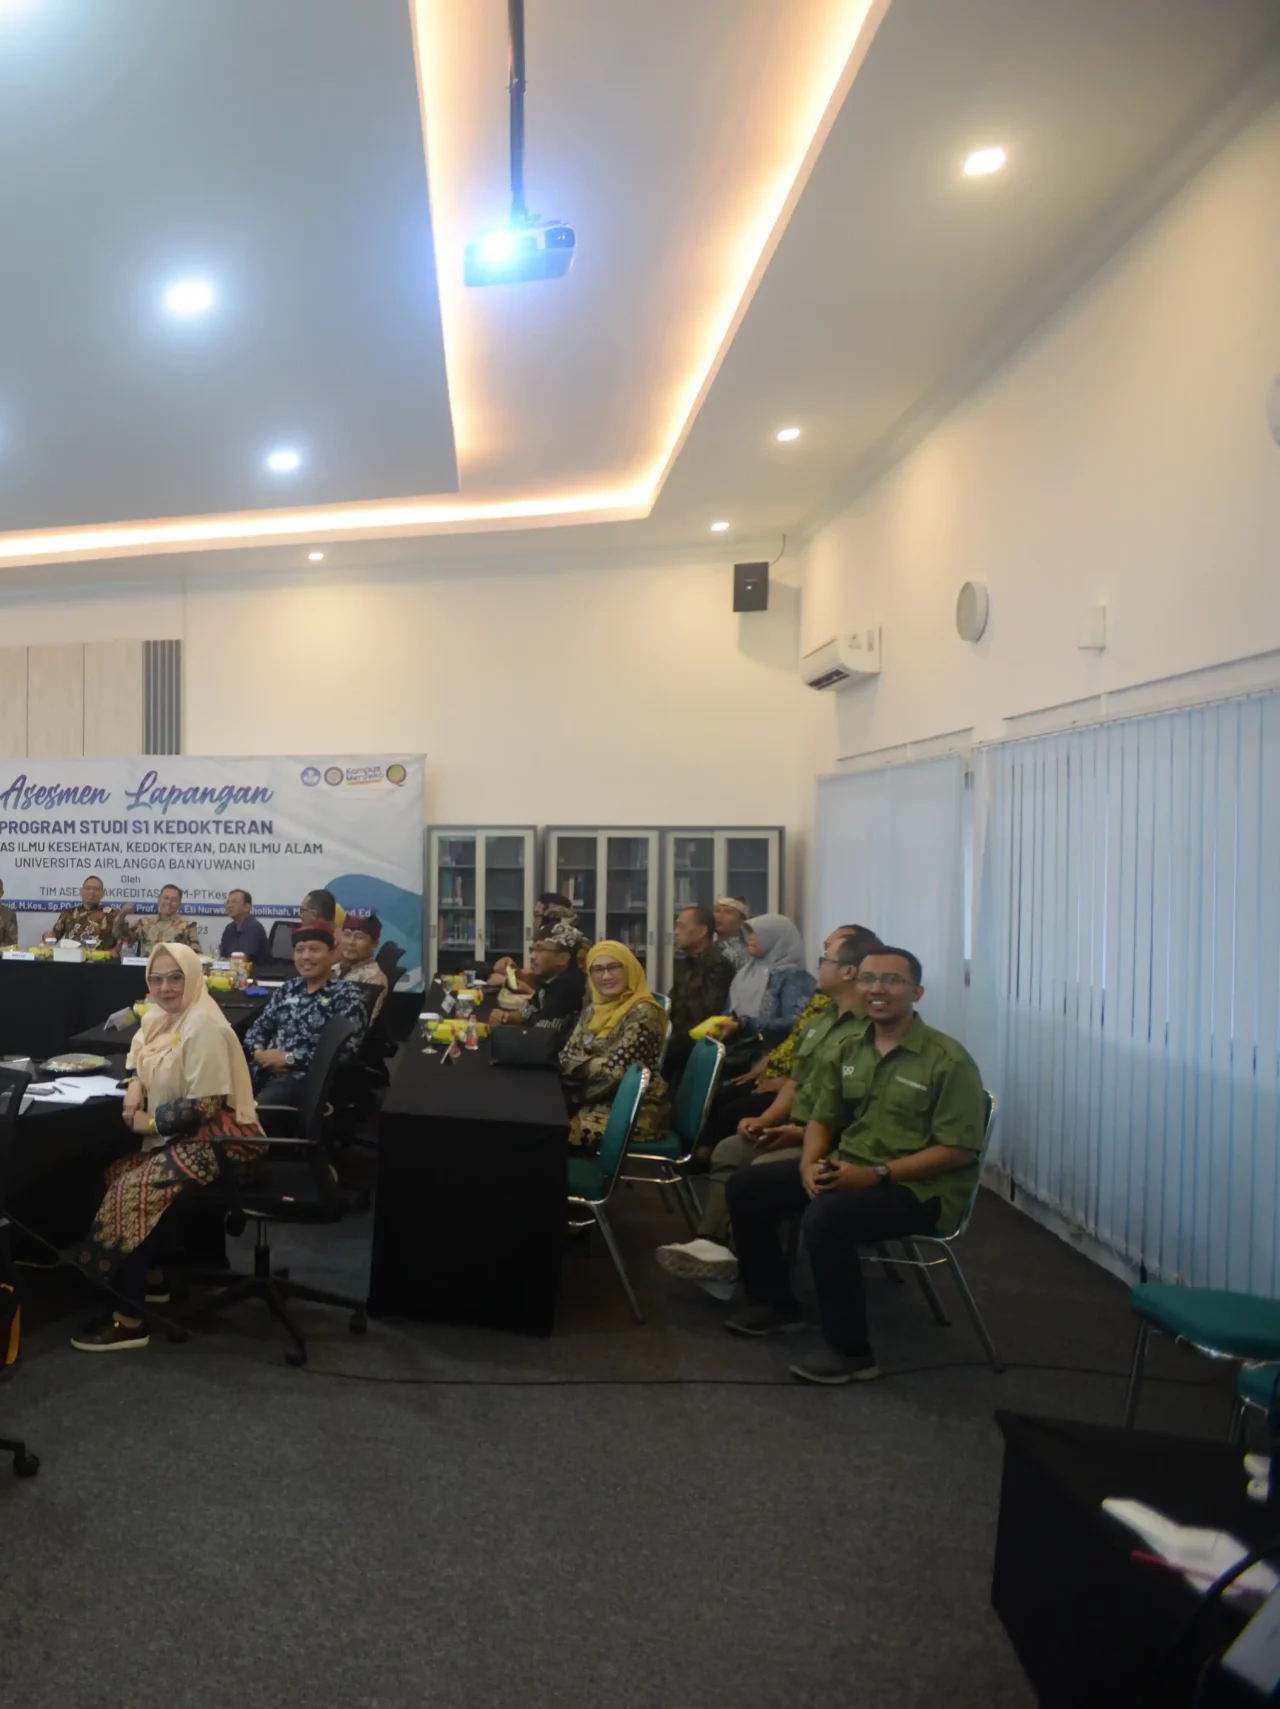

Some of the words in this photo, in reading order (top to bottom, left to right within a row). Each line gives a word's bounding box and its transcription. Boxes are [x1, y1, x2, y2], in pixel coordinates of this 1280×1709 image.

[0, 774, 111, 811] Asesmen
[124, 770, 275, 815] Lapangan
[79, 820, 128, 835] STUDI
[132, 820, 150, 835] S1
[153, 820, 274, 835] KEDOKTERAN
[17, 841, 46, 853] ILMU
[48, 841, 123, 854] KESEHATAN,
[126, 842, 216, 855] KEDOKTERAN,
[219, 842, 246, 854] DAN
[249, 842, 282, 854] ILMU
[284, 843, 324, 855] ALAM
[14, 857, 92, 869] UNIVERSITAS
[94, 858, 166, 870] AIRLANGGA
[168, 858, 256, 871] BANYUWANGI
[120, 874, 141, 884] Oleh
[40, 886, 57, 897] TIM
[102, 887, 160, 899] AKREDITAS
[181, 888, 227, 900] M-PTKes
[136, 903, 157, 913] Prof.
[184, 905, 196, 914] Eti
[198, 905, 227, 915] Nurwe
[250, 907, 291, 917] holikhah,
